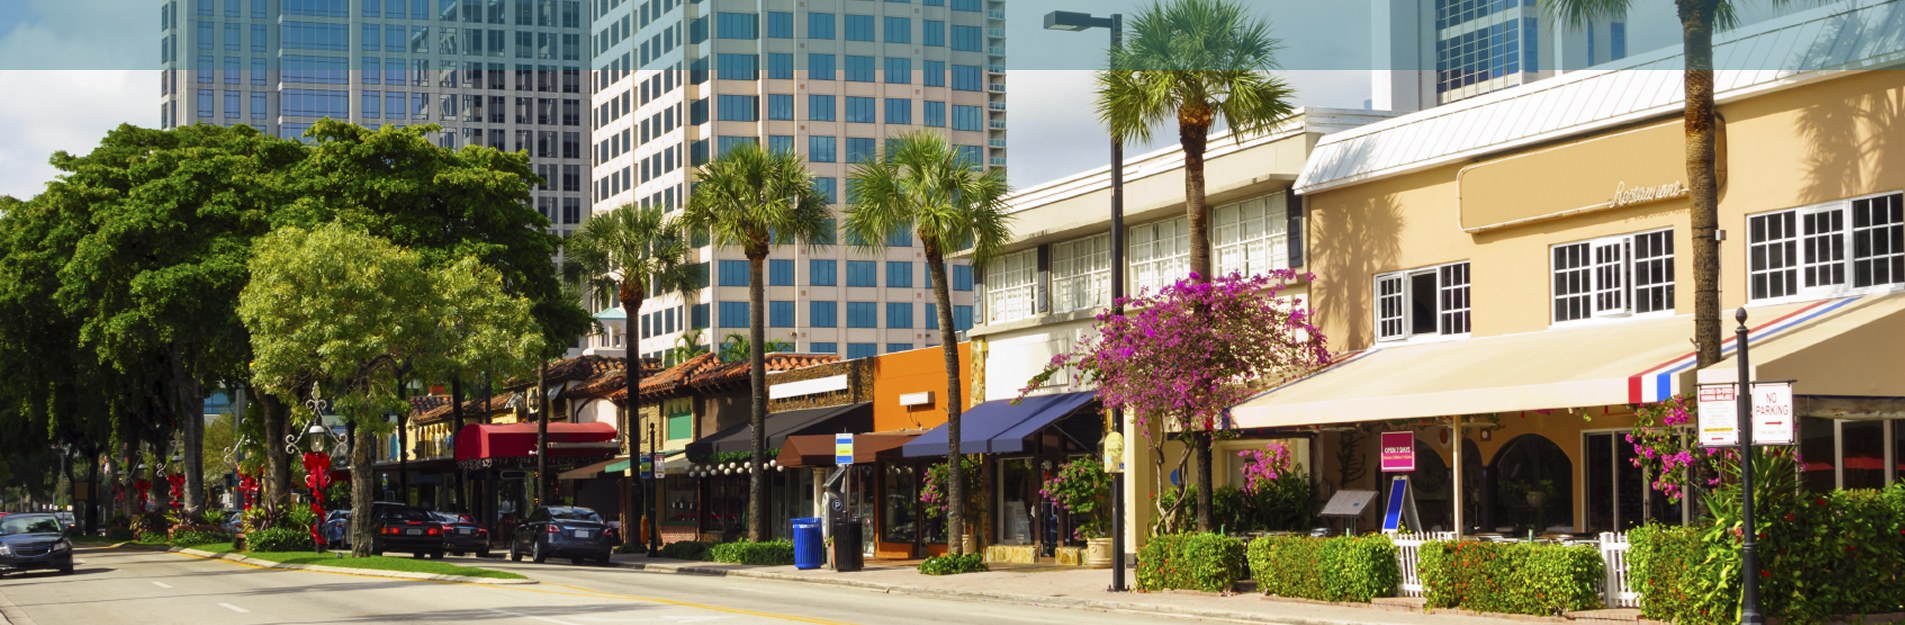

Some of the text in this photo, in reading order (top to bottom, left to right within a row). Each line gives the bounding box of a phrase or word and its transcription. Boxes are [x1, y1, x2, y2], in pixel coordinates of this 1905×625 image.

[1609, 180, 1681, 208] Restaurant
[1766, 392, 1777, 404] NO
[1756, 404, 1789, 416] PARKING
